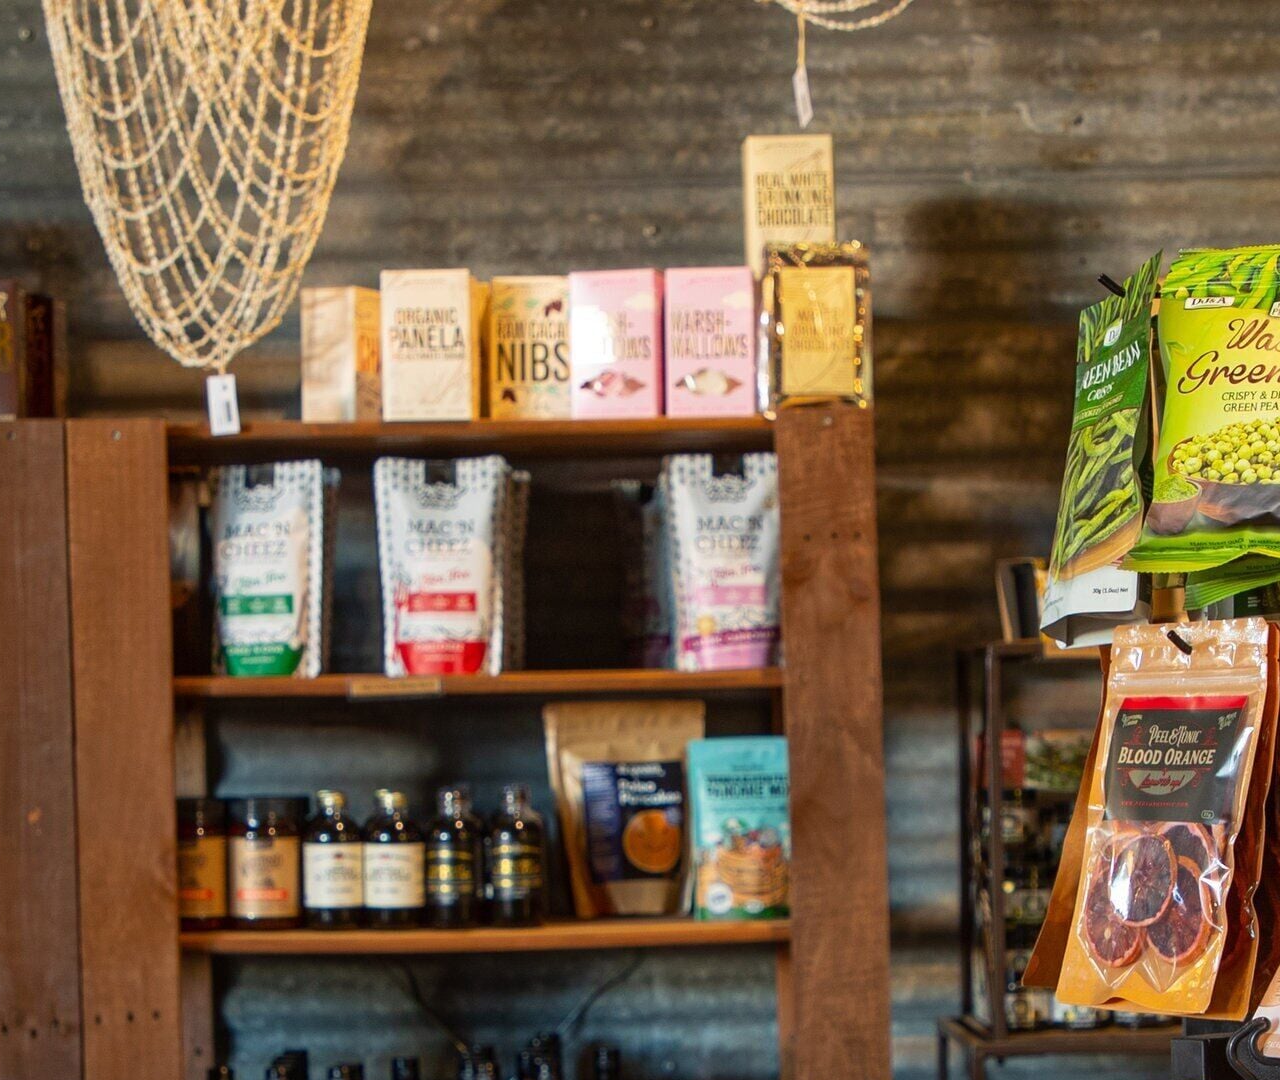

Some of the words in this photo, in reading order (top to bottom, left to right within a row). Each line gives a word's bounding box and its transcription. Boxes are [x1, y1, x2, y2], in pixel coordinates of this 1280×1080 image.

[395, 307, 458, 326] ORGANIC
[389, 326, 465, 350] PANELA
[496, 341, 570, 383] NIBS
[1112, 340, 1141, 377] BEAN
[1222, 391, 1255, 401] CRISPY
[1223, 403, 1257, 412] GREEN
[1260, 403, 1279, 411] PEA
[1118, 747, 1162, 764] BLOOD
[1164, 748, 1217, 766] ORANGE
